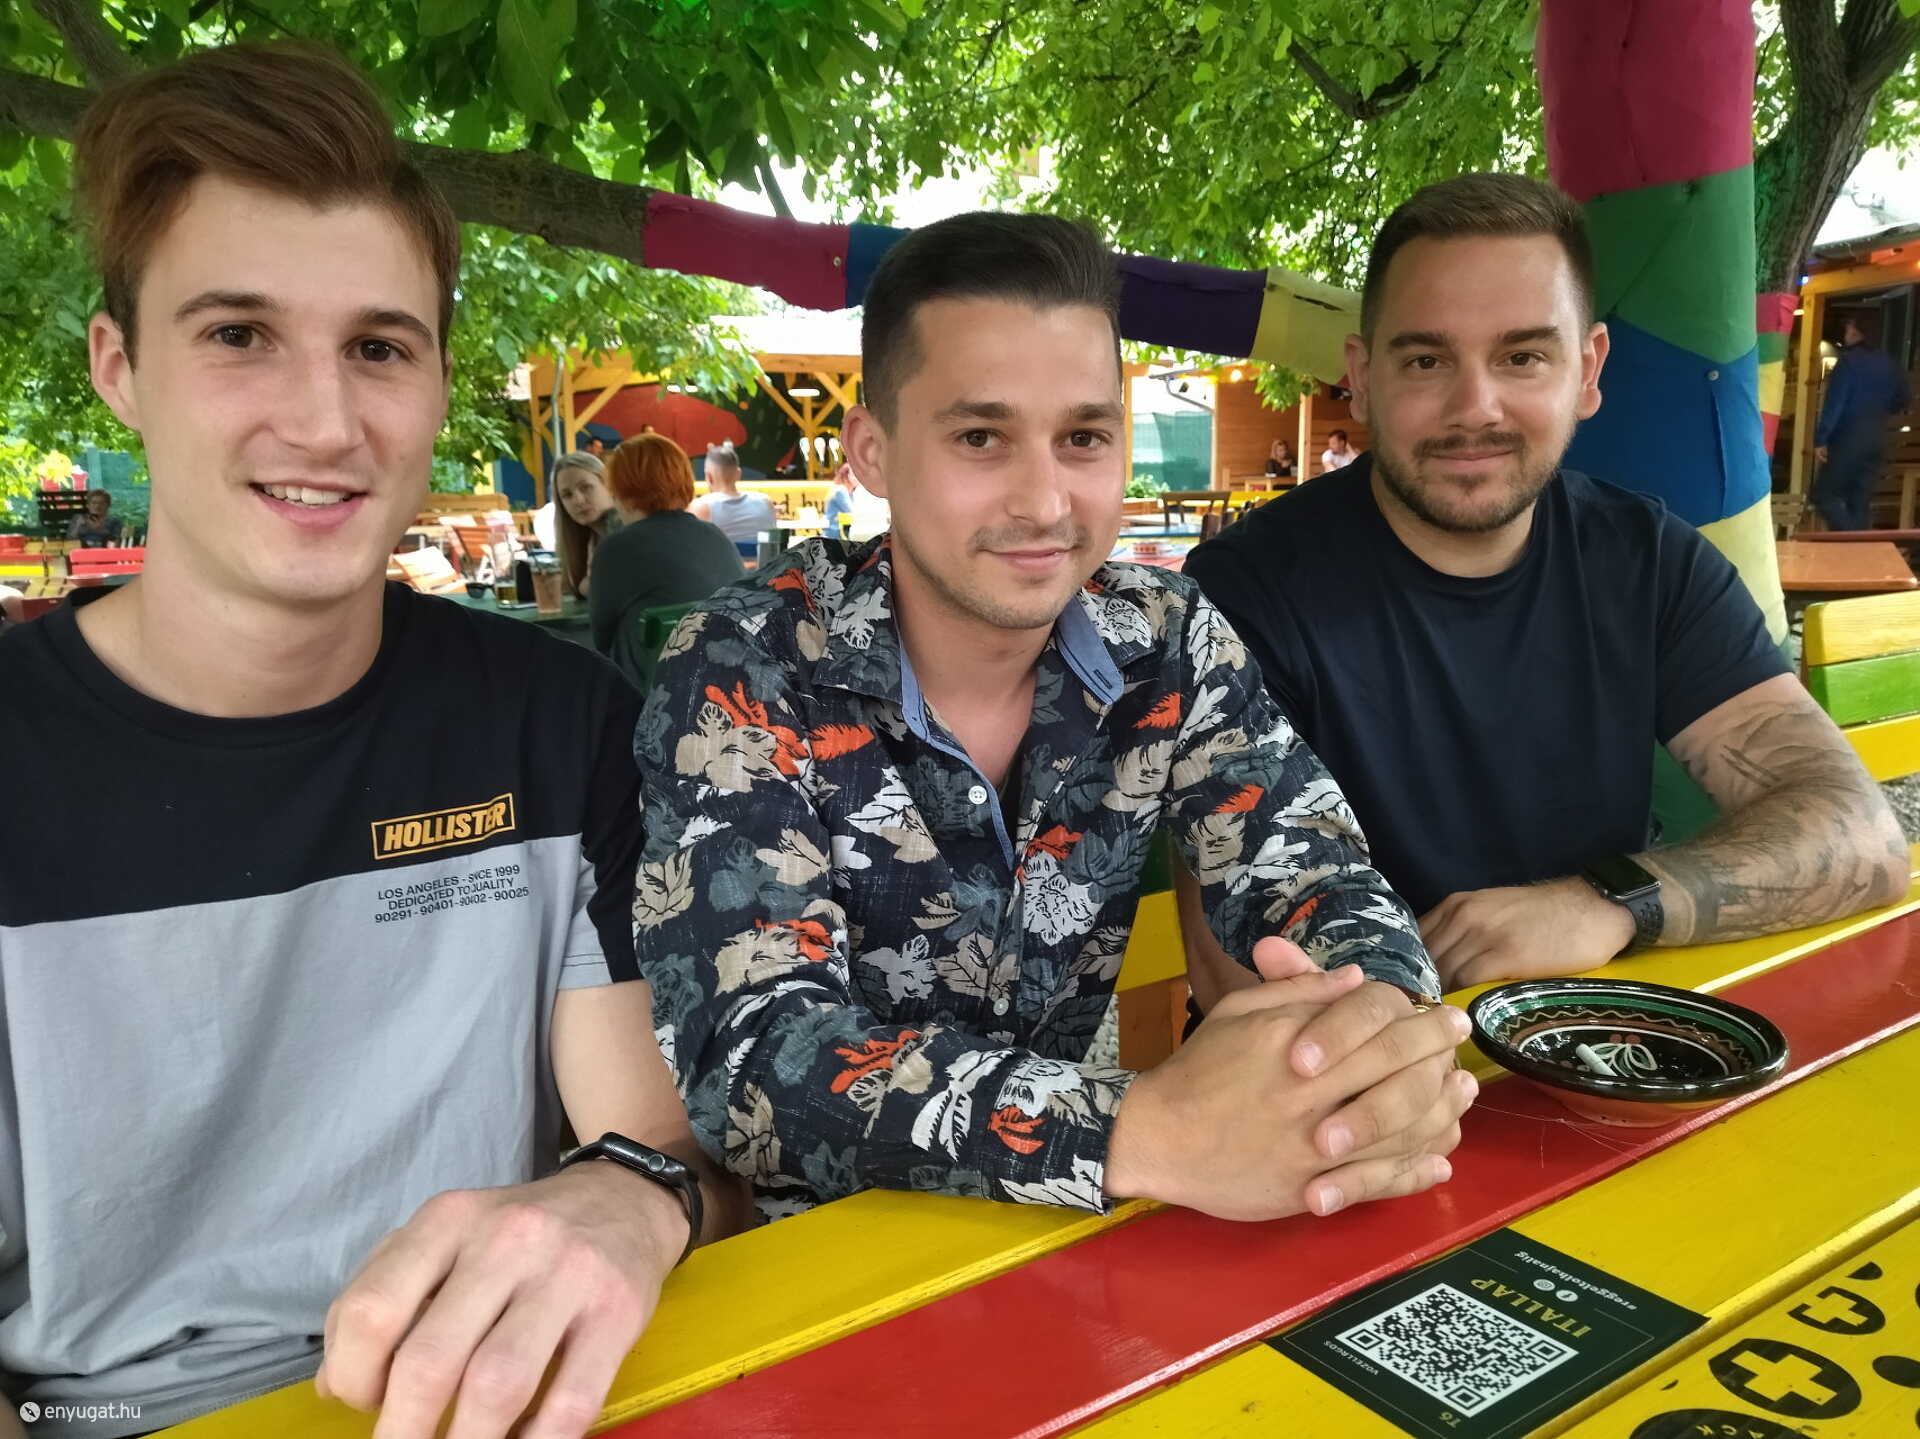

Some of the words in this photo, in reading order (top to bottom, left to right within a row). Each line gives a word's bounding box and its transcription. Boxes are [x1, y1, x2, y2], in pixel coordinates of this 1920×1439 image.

[383, 802, 507, 851] HOLLISTER
[378, 887, 404, 901] LOS
[406, 876, 459, 896] ANGELES
[494, 864, 520, 877] 1999
[388, 887, 454, 910] DEDICATED
[457, 885, 471, 896] TO
[471, 877, 514, 892] UALITY
[375, 906, 412, 923] 90291
[420, 900, 453, 916] 90401
[494, 886, 529, 901] 90025
[1471, 1279, 1592, 1337] ITALLAP
[1440, 1412, 1461, 1428] T6
